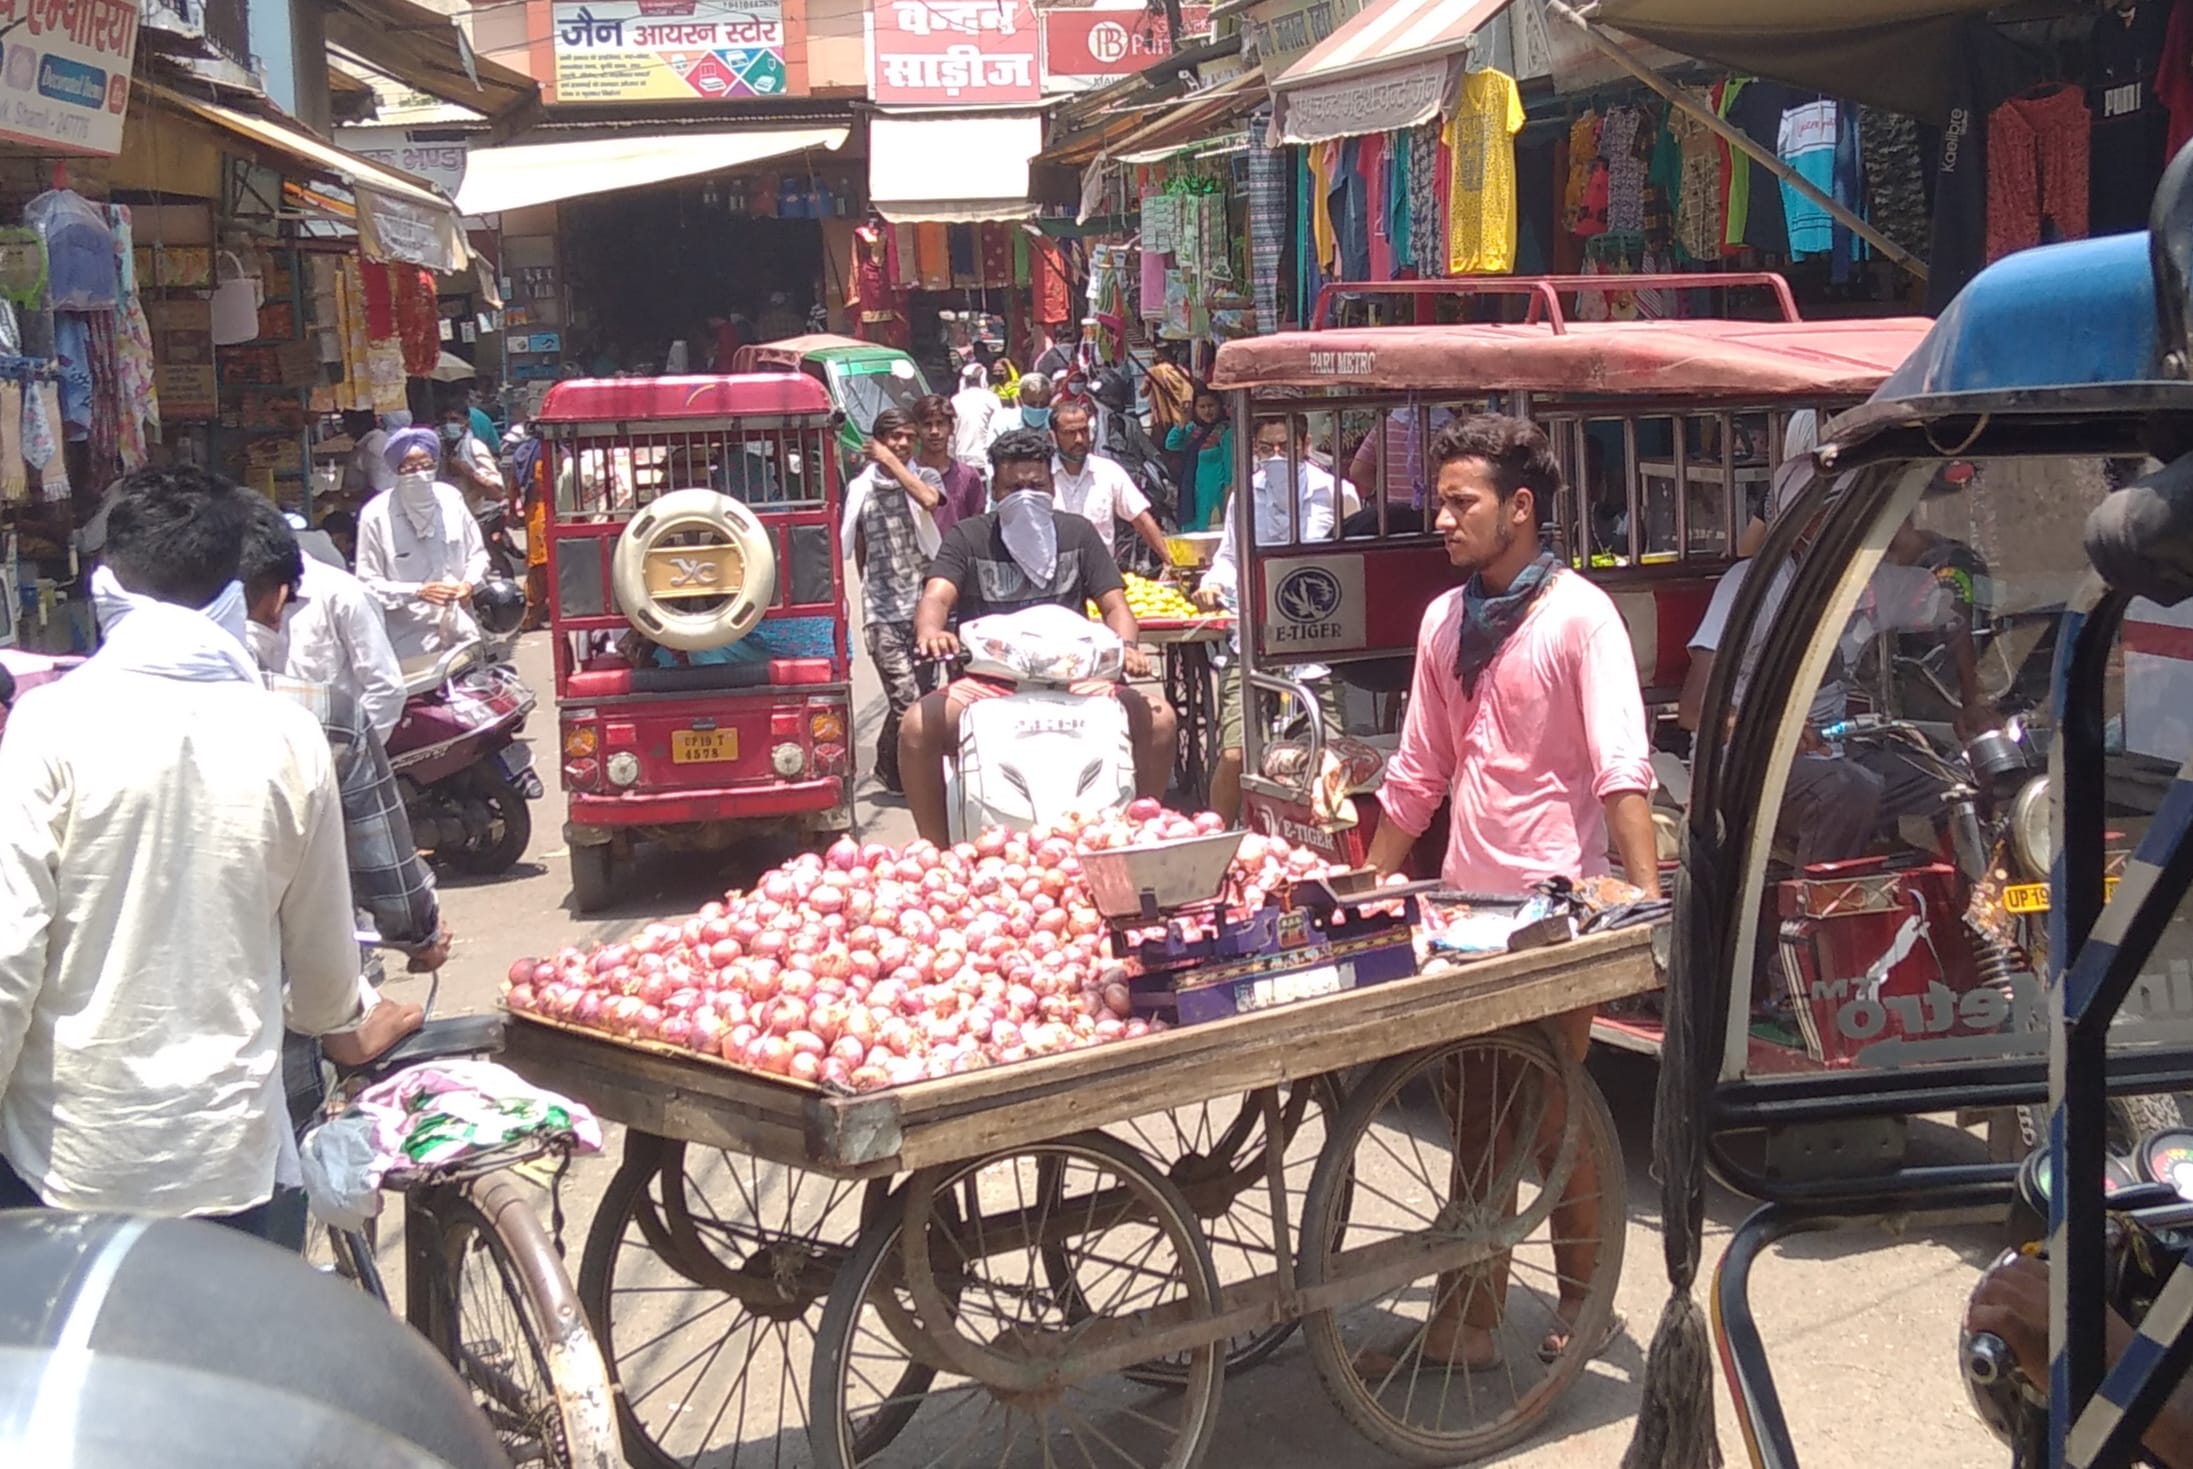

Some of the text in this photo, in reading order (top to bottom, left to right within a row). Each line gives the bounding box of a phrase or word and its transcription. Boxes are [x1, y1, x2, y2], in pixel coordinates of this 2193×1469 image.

[557, 6, 625, 47] जैन
[633, 22, 719, 45] आयरन
[724, 13, 778, 43] स्टोर
[879, 44, 1034, 97] साड़ीज
[1310, 352, 1336, 374] PARI
[1276, 623, 1343, 642] E-TIGER
[1283, 820, 1334, 850] E-TIGER
[2008, 889, 2028, 909] UP
